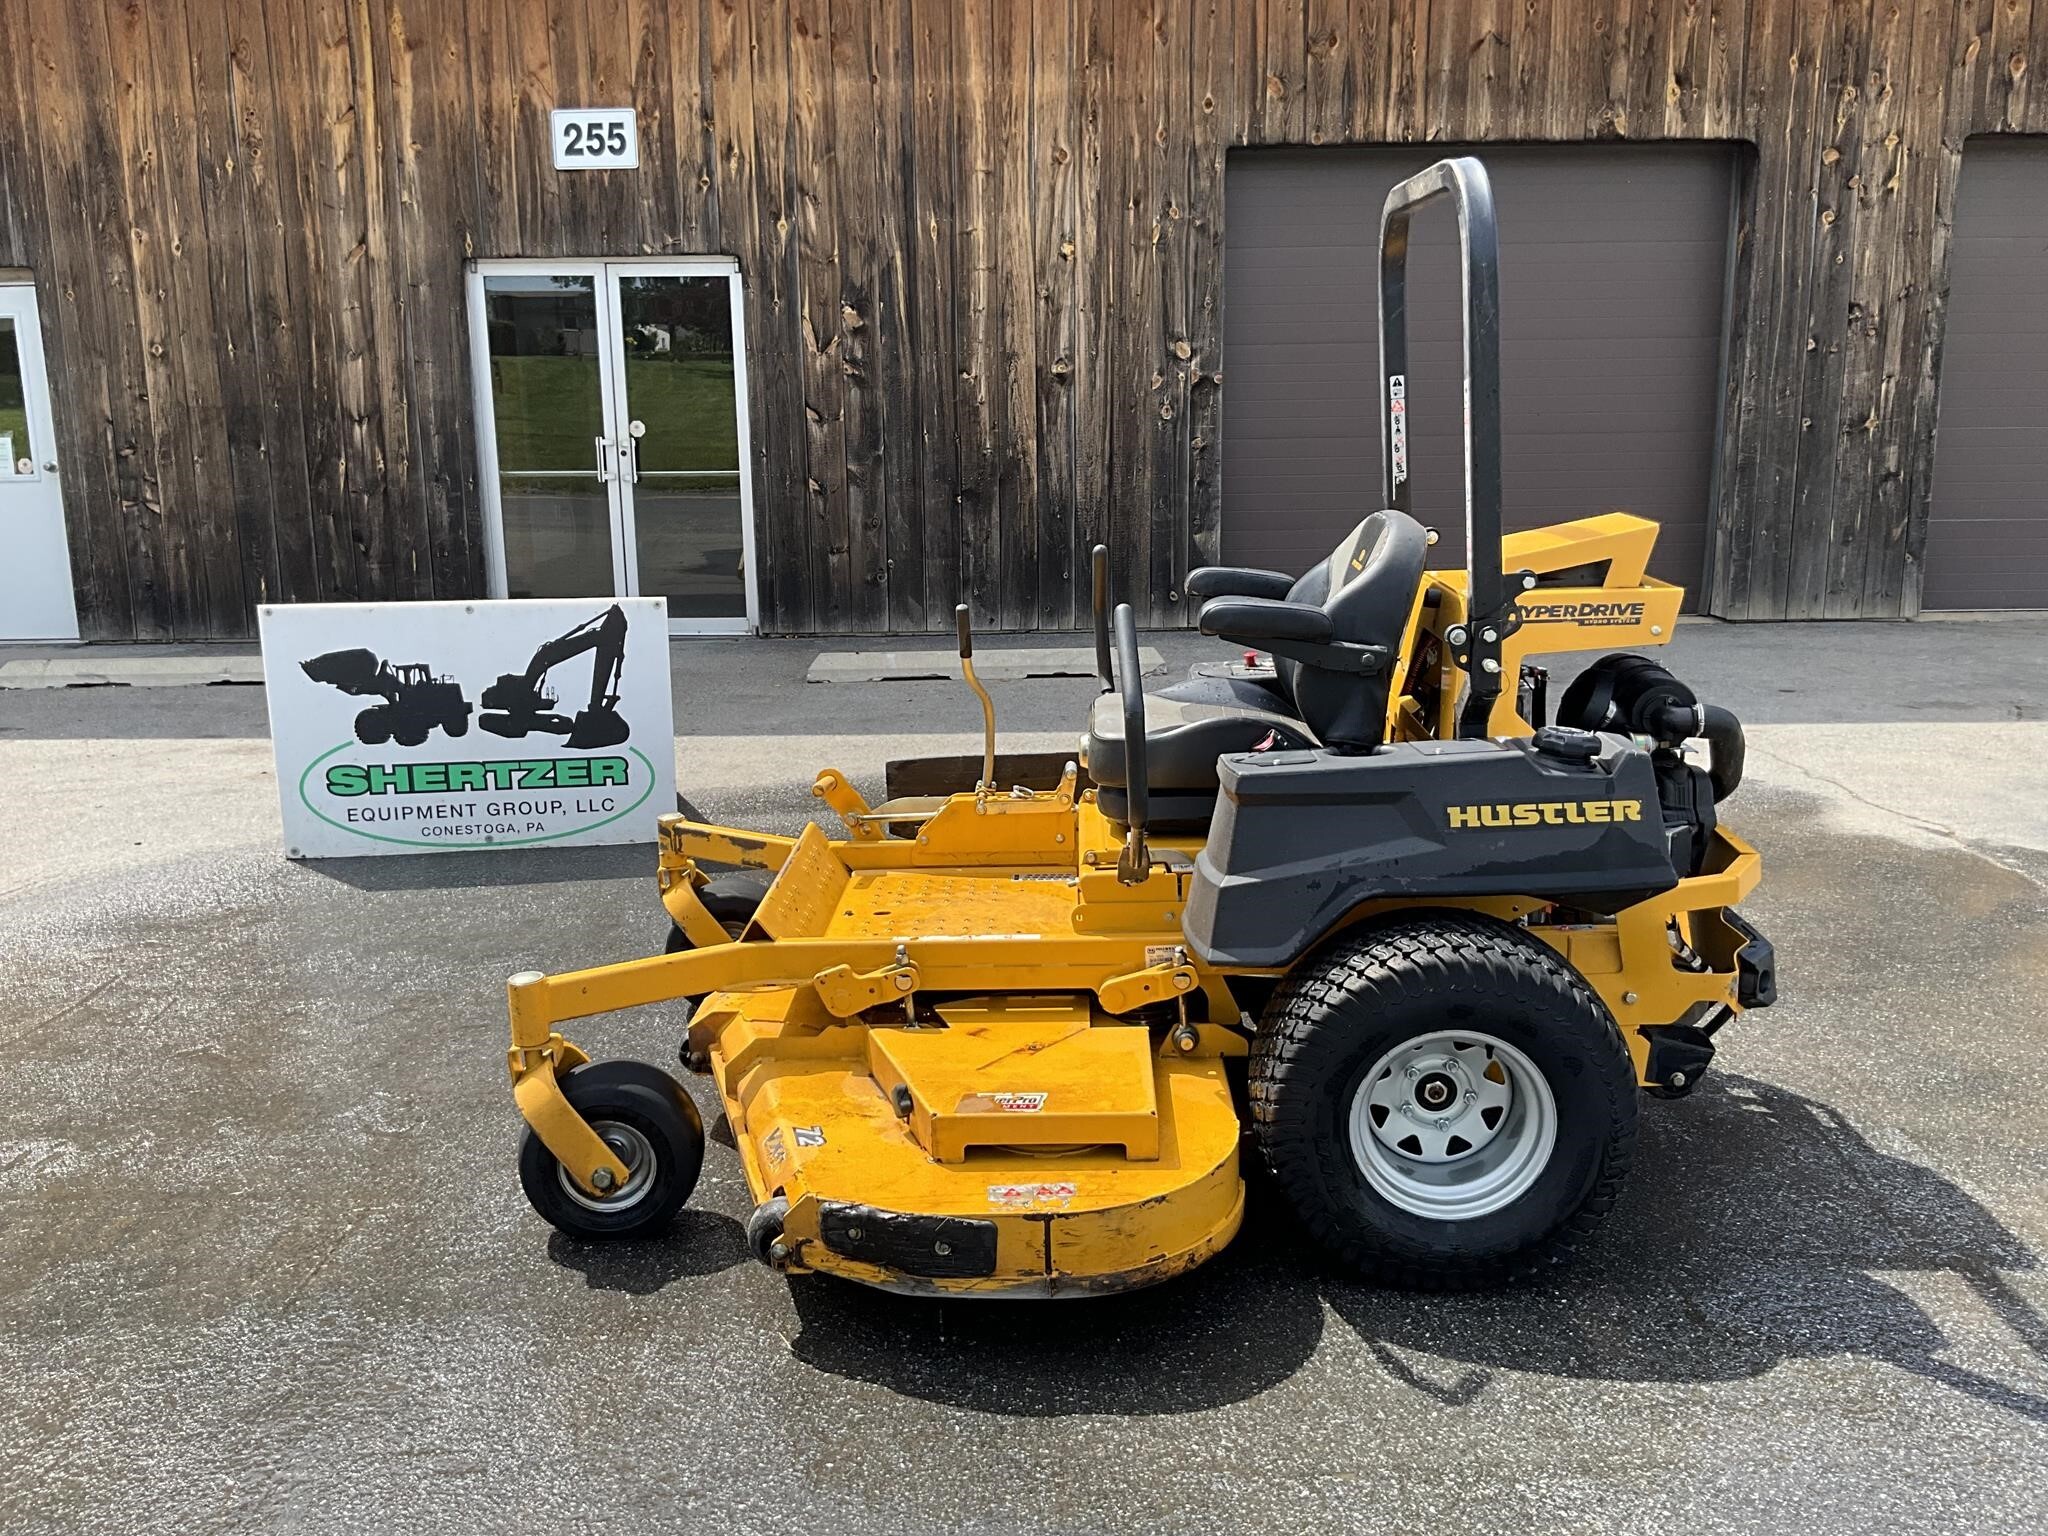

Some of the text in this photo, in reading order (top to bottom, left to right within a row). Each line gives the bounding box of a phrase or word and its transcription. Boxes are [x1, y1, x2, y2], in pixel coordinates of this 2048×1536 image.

[564, 122, 627, 156] 255
[1519, 603, 1645, 618] YPERDRIVE
[326, 756, 629, 796] SHERTZER
[347, 798, 615, 822] EQUIPMENT GROUP, LLC
[1447, 800, 1641, 828] HUSTLER
[421, 822, 545, 837] CONESTOGA, PA
[996, 1096, 1037, 1104] erPro
[792, 1126, 827, 1147] 72
